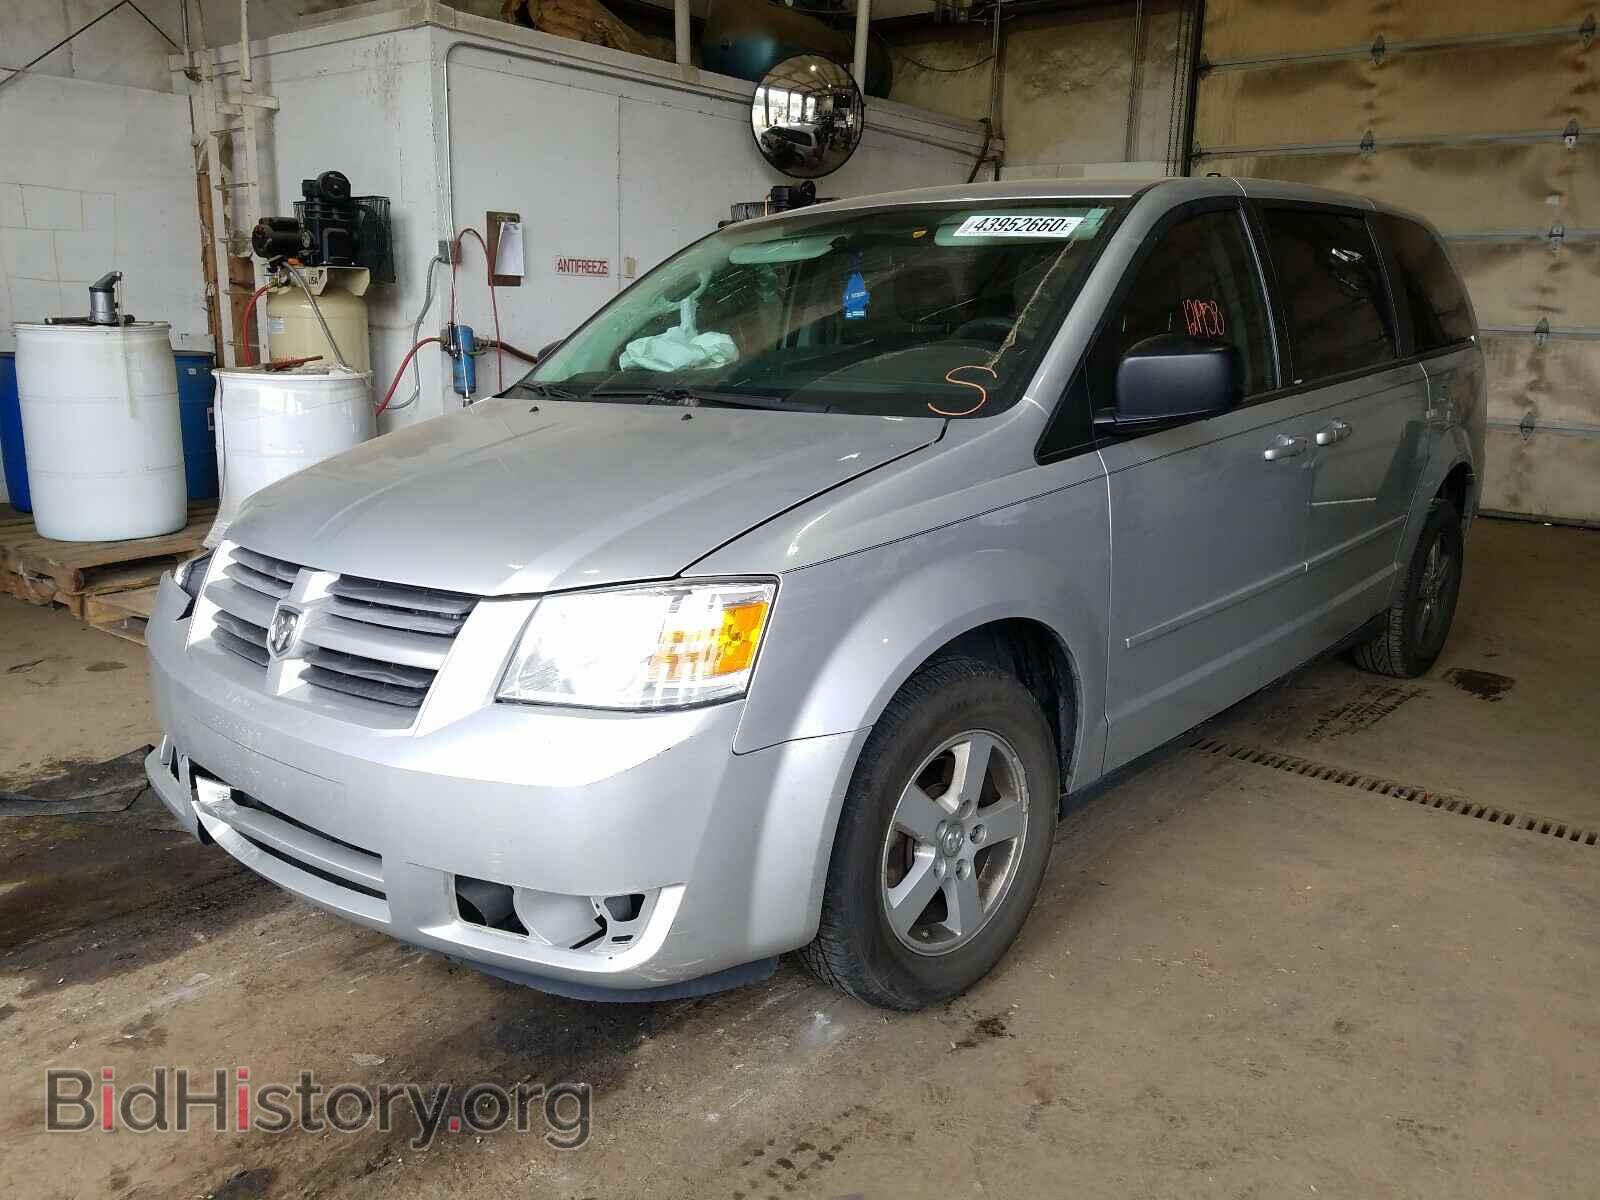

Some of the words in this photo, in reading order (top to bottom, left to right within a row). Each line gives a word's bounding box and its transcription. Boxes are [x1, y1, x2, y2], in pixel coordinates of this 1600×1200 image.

[974, 217, 1066, 232] 43952660
[557, 258, 608, 274] ANTIFREEZE
[928, 365, 998, 416] S
